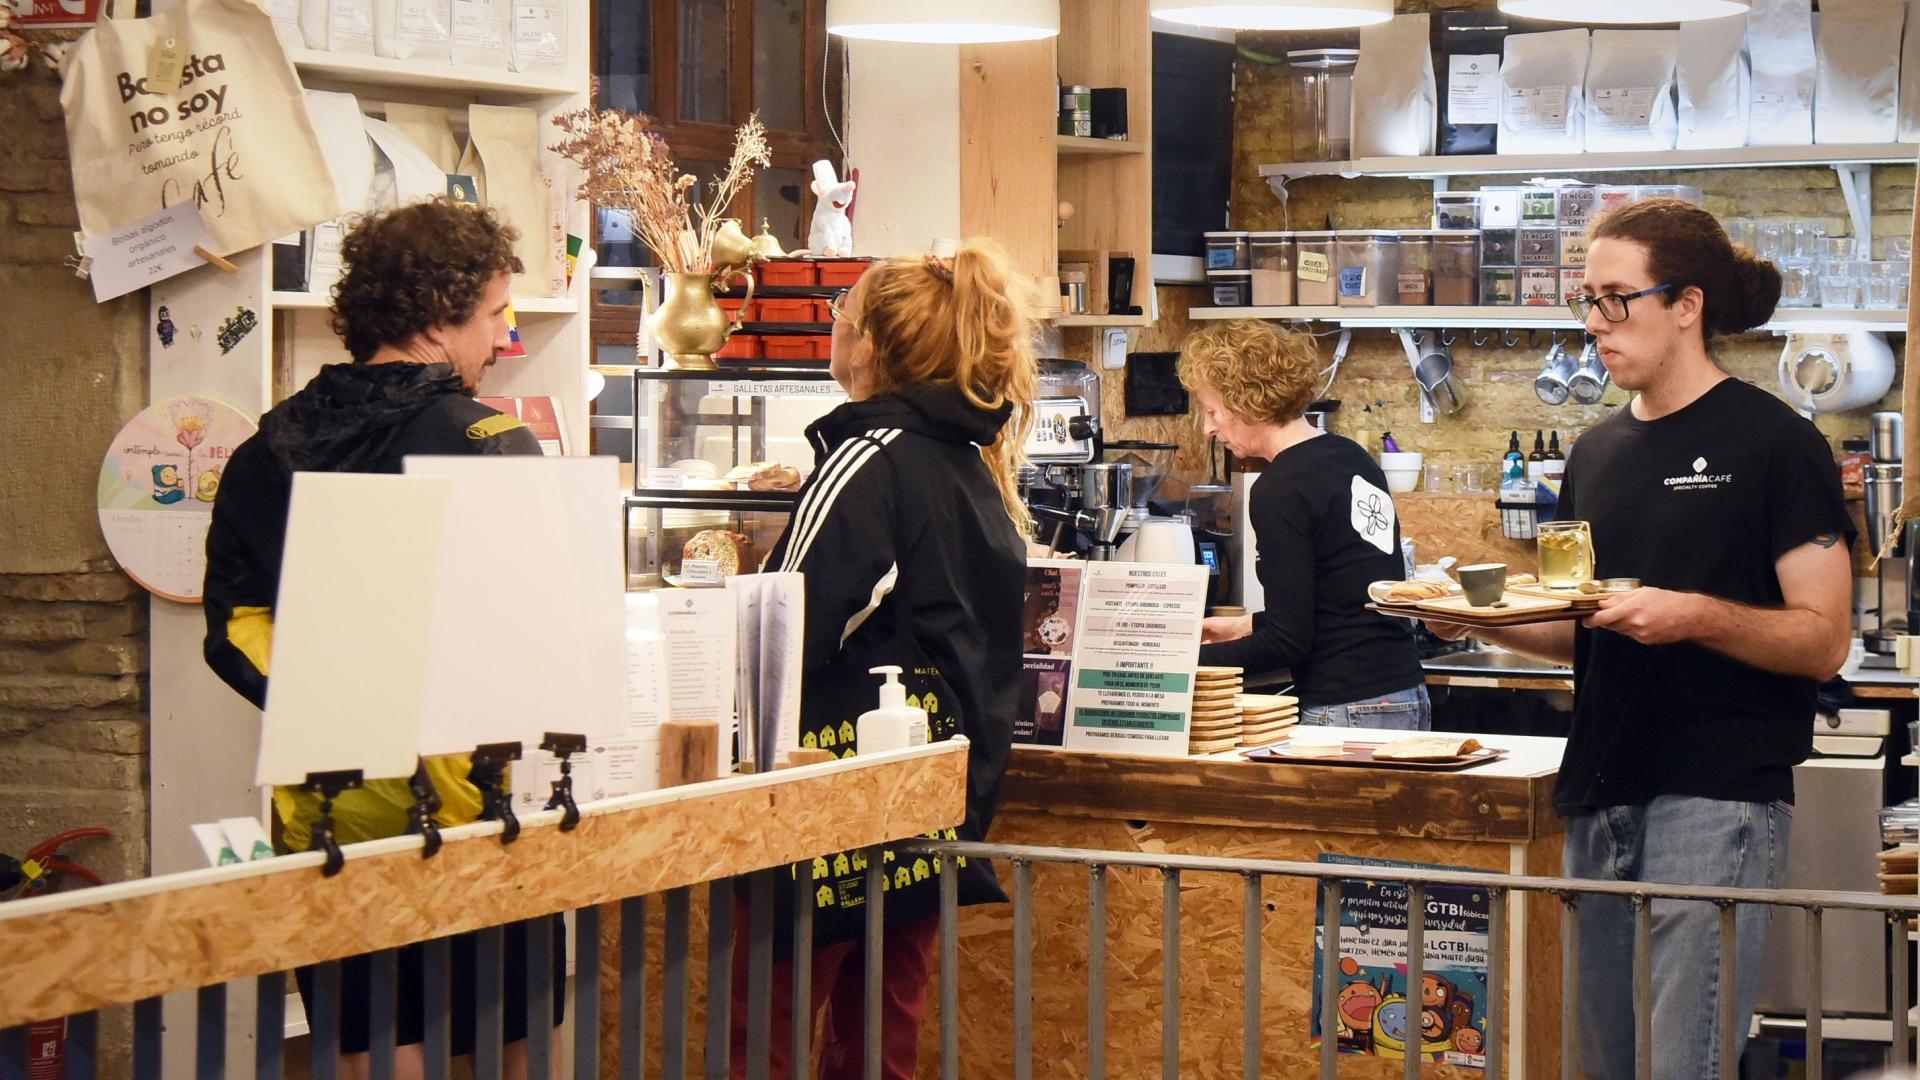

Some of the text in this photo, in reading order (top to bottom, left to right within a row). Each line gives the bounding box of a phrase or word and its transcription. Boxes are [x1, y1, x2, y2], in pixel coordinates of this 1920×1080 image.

[130, 84, 228, 133] no soy
[129, 142, 154, 157] Pero
[154, 129, 194, 144] tengo
[142, 149, 200, 175] tomando
[111, 213, 174, 247] Bolsas algodón
[128, 233, 167, 254] orgánico
[127, 244, 177, 269] artesanales
[733, 384, 831, 394] GALLETAS ARTESANALES
[1120, 661, 1149, 669] IMPORTANTE
[1380, 886, 1391, 897] En
[1368, 912, 1384, 923] nos
[1384, 914, 1407, 926] gusta
[1424, 919, 1467, 931] iversidad
